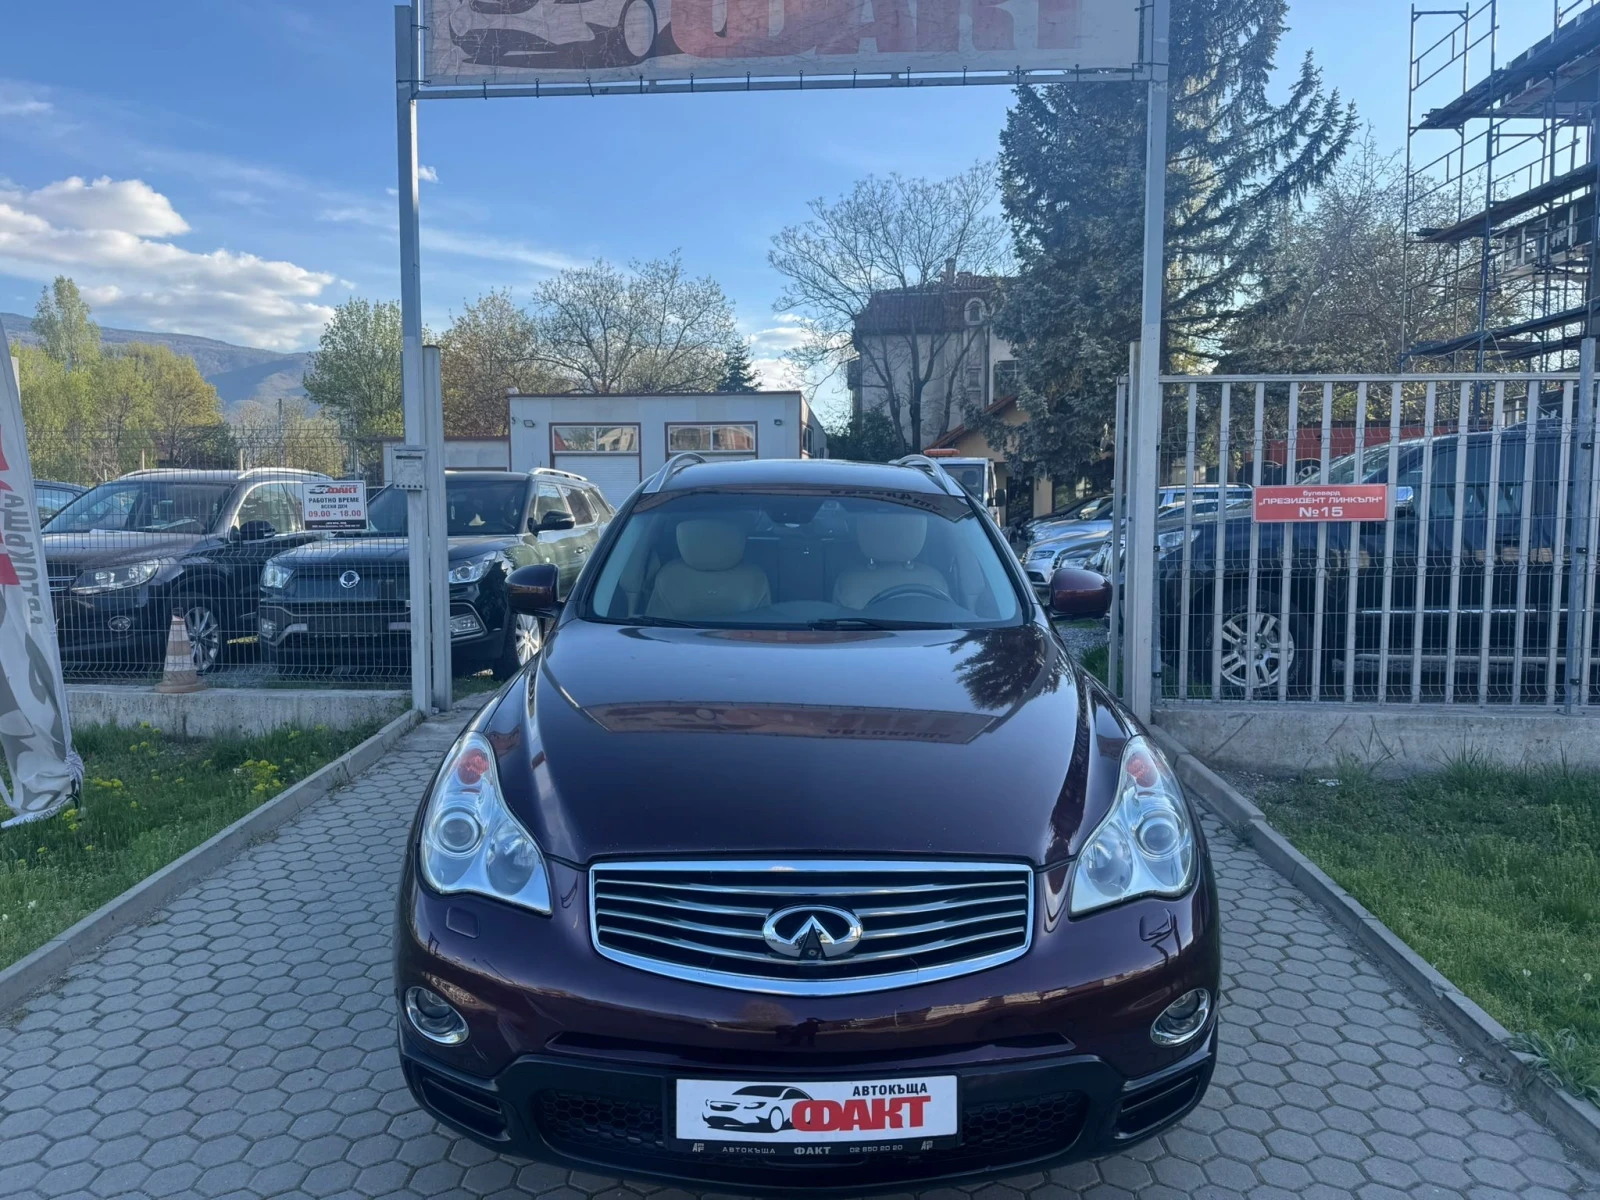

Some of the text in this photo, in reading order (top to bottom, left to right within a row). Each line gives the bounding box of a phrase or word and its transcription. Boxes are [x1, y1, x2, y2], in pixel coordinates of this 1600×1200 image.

[308, 510, 331, 518] 09.00
[339, 509, 362, 517] 18.00
[852, 1082, 928, 1097] АВТОКЪЩА
[791, 1095, 931, 1132] ФАКТ
[793, 1146, 831, 1155] ФАКТ
